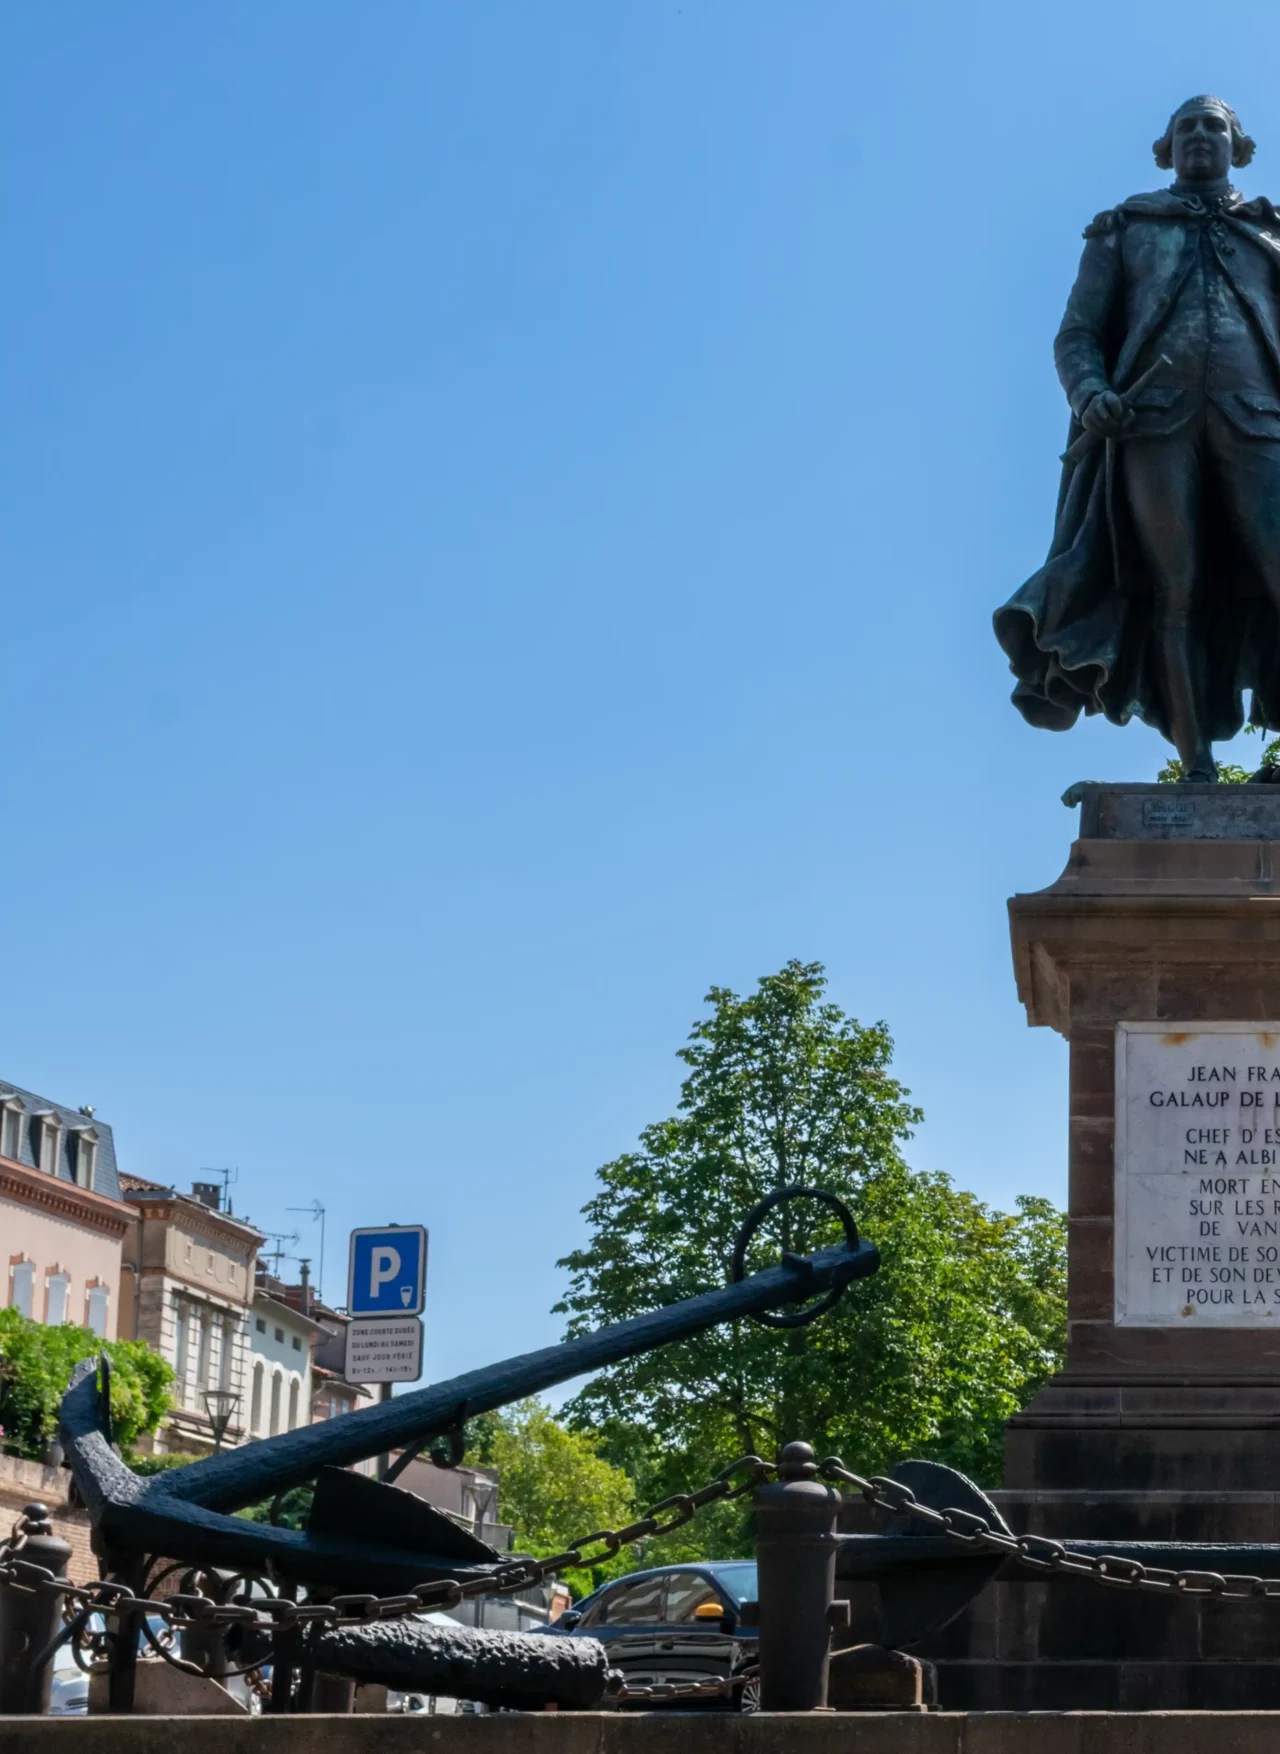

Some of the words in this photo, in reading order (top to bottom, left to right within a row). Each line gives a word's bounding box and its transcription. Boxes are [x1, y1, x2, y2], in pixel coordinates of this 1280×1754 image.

[1186, 1066, 1237, 1082] JEAN
[1148, 1091, 1230, 1107] GALAUP
[1239, 1091, 1265, 1107] DE
[1185, 1128, 1231, 1144] CHEF
[1184, 1150, 1208, 1164] NE
[1214, 1149, 1228, 1164] A
[1235, 1150, 1276, 1164] ALBI
[1199, 1179, 1250, 1194] MORT
[1189, 1200, 1224, 1216] SUR
[1235, 1200, 1265, 1216] LES
[1199, 1221, 1221, 1236] DE
[1145, 1246, 1222, 1262] VICTIME
[1228, 1247, 1250, 1262] DE
[369, 1246, 401, 1298] P
[1151, 1268, 1174, 1283] ET
[1181, 1268, 1203, 1282] DE
[1209, 1268, 1246, 1283] SON
[1185, 1289, 1236, 1304] POUR
[1242, 1290, 1266, 1304] LA
[369, 1327, 393, 1335] COURTE
[394, 1325, 415, 1334] DURÉE
[380, 1340, 389, 1348] AU
[390, 1339, 414, 1347] SAMEDI
[352, 1354, 370, 1362] SAUF
[372, 1353, 391, 1361] JOUR
